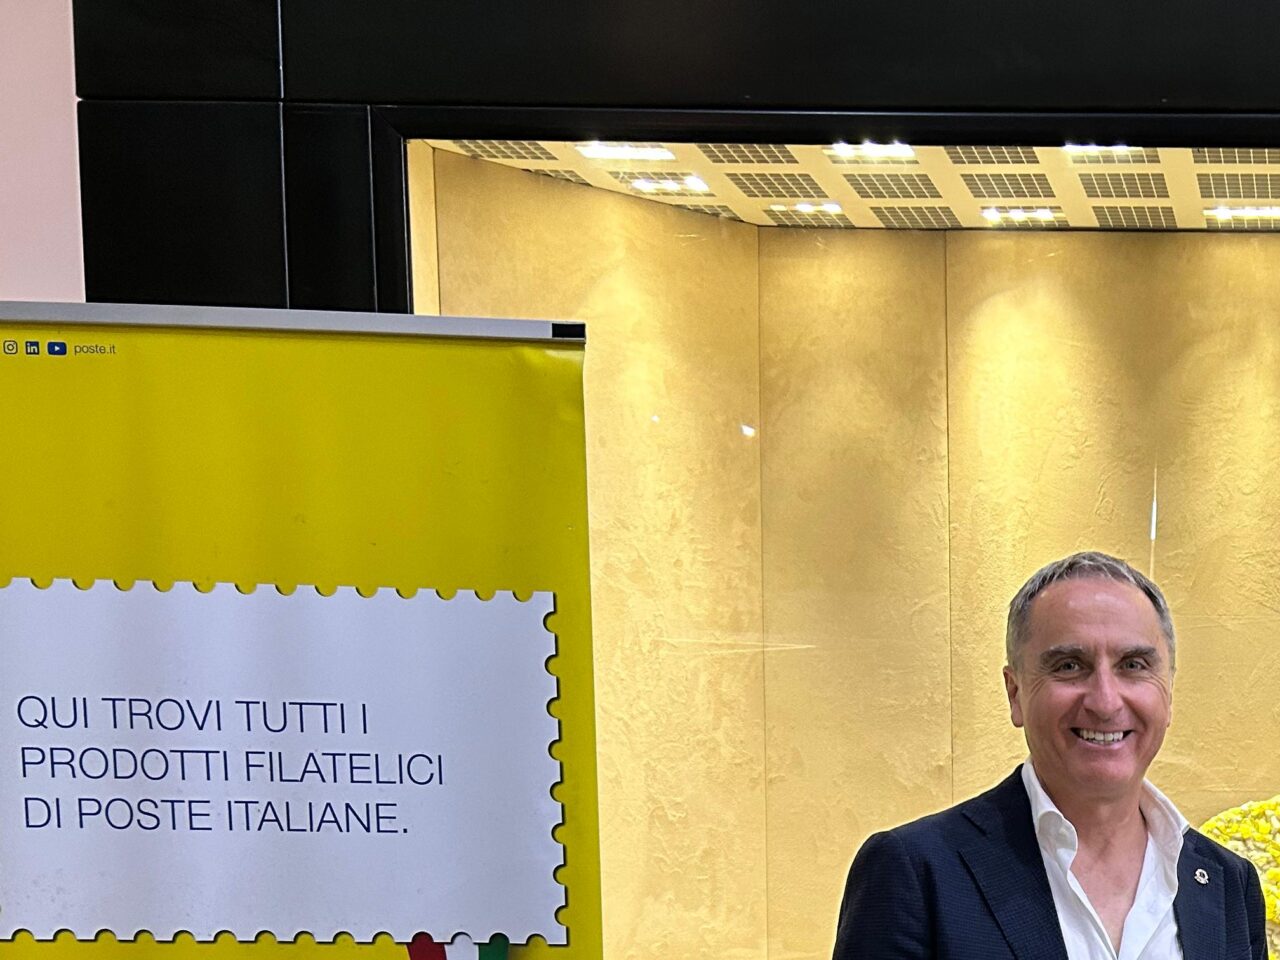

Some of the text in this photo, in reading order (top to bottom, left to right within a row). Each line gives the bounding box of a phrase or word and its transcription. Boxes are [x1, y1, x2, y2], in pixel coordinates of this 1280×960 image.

[74, 344, 116, 356] poste.it
[17, 695, 368, 735] QUI TROVI TUTTI I
[21, 747, 443, 785] PRODOTTI FILATELICI
[24, 797, 409, 834] DI POSTE ITALIANE.
